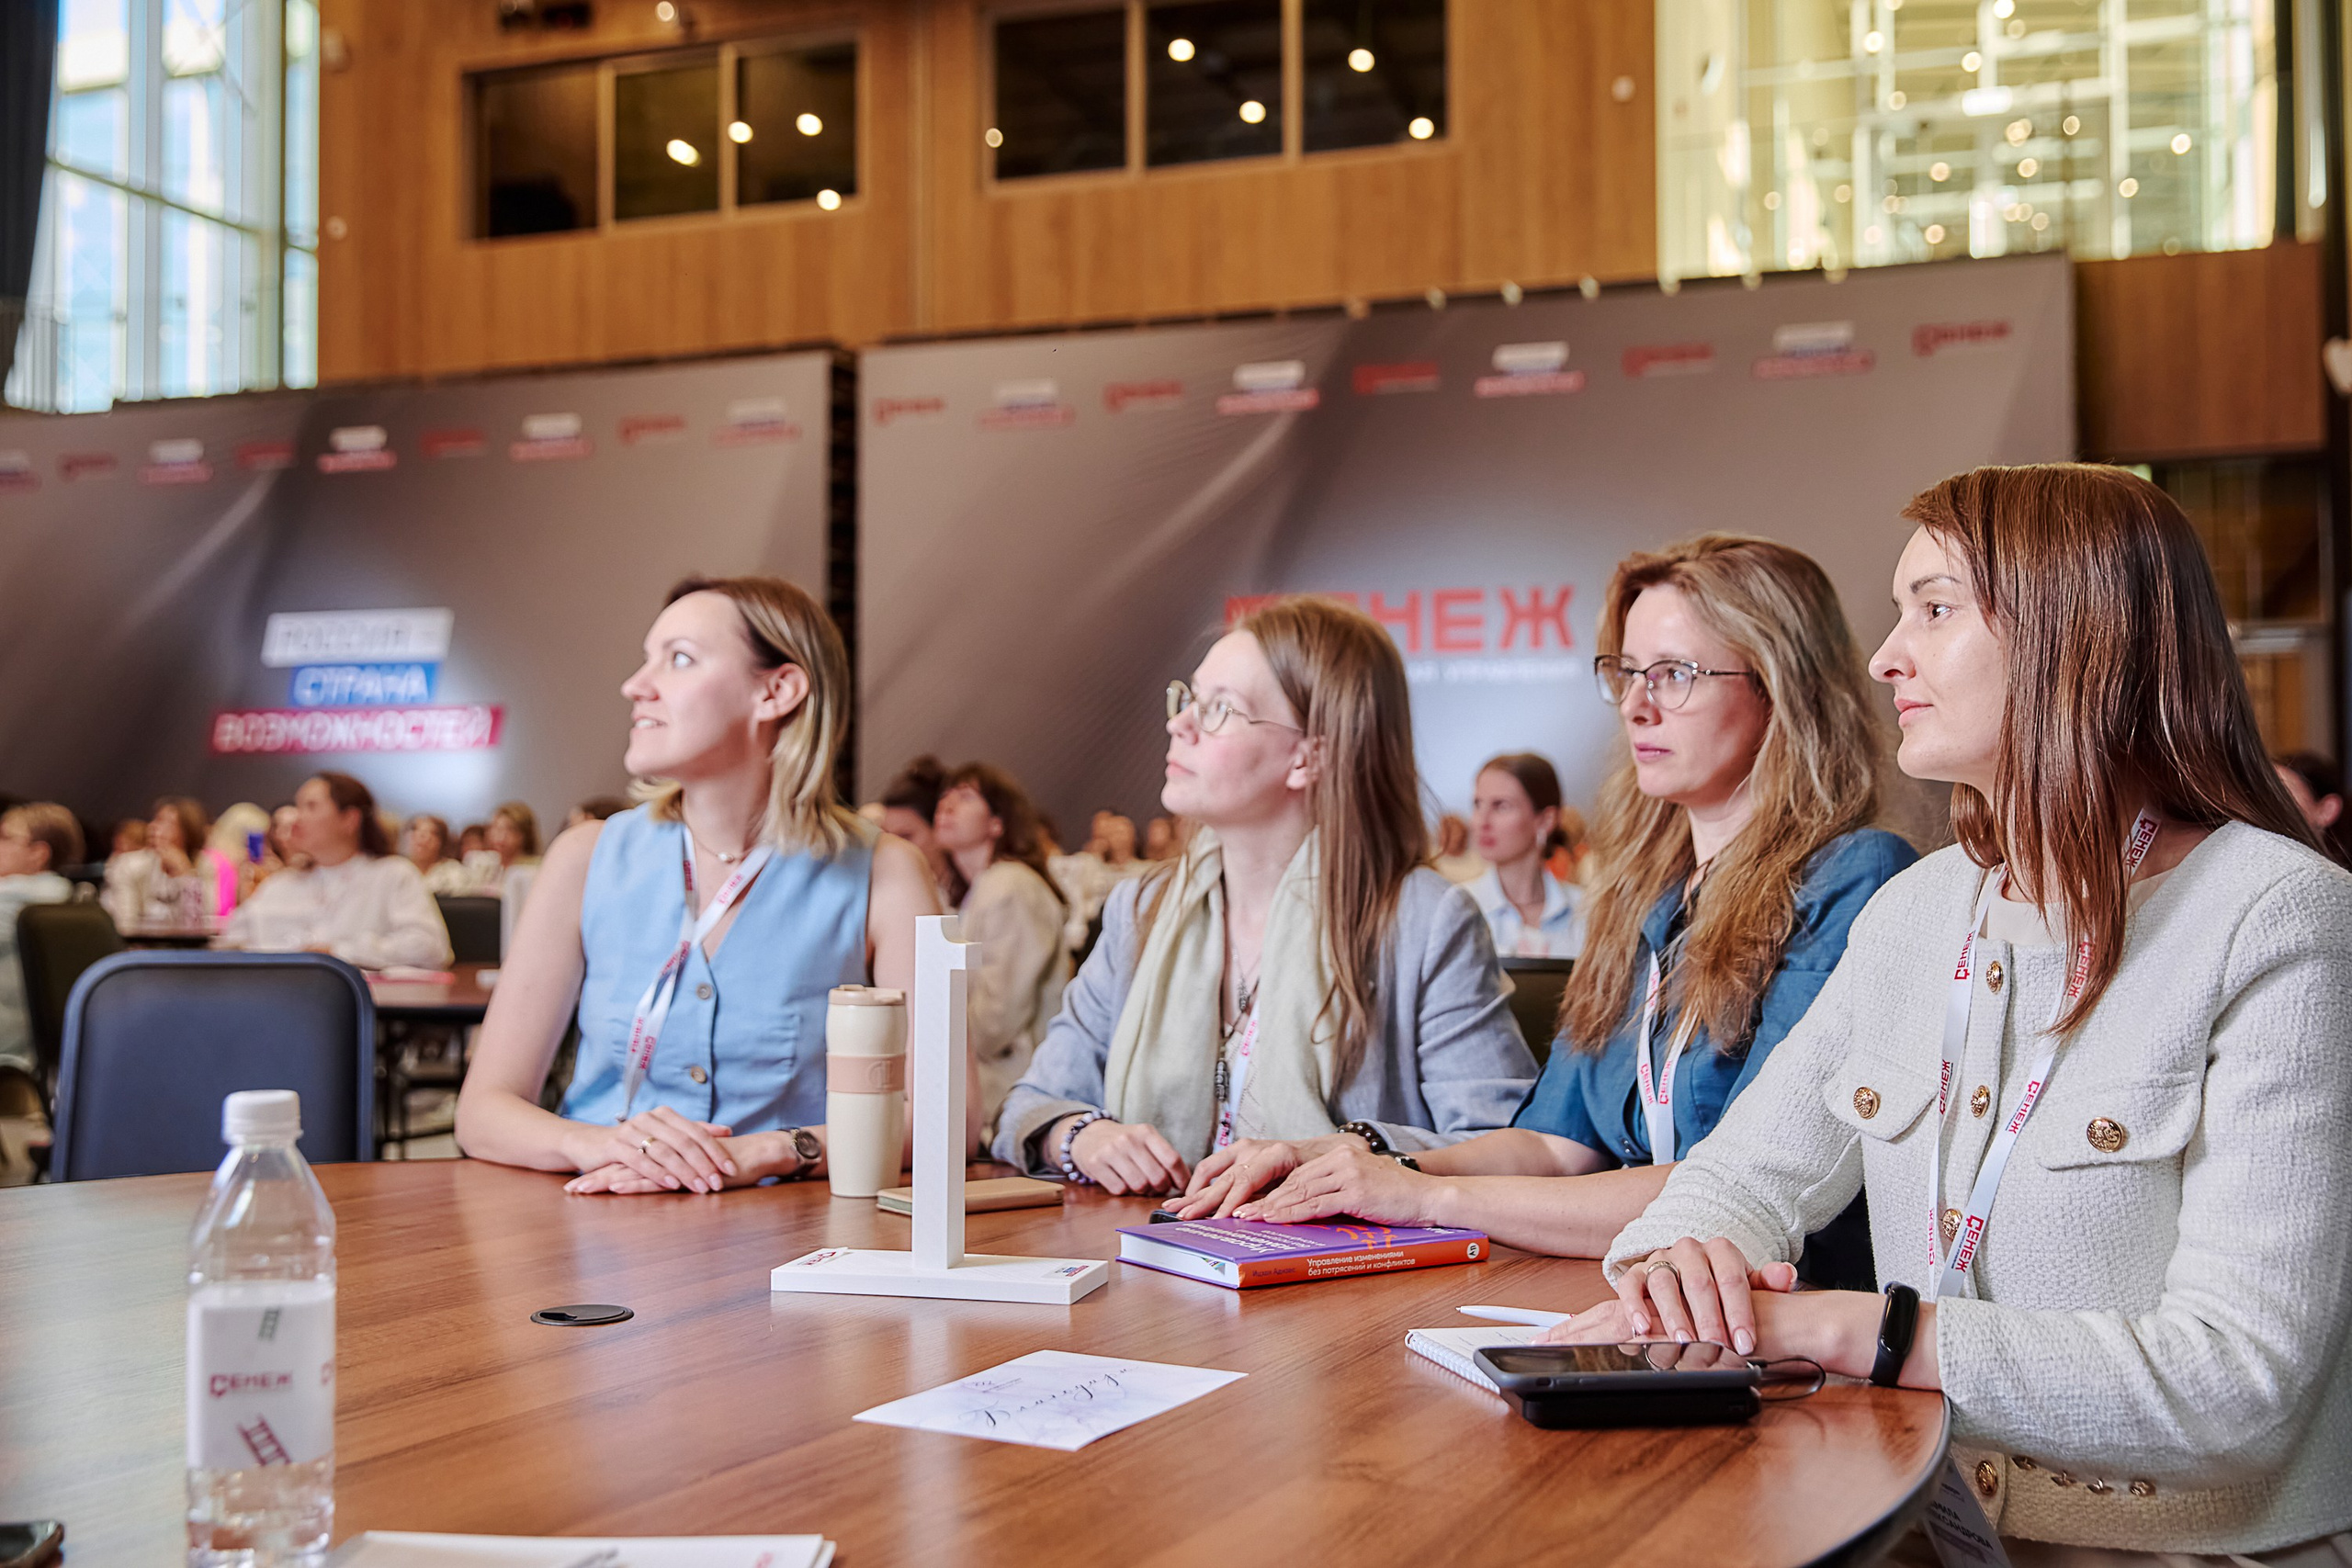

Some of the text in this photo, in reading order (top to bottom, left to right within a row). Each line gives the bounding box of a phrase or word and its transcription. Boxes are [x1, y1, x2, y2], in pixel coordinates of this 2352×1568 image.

[294, 665, 428, 705] СТРАНА
[212, 705, 493, 752] ВОЗМОЖНОСТЕЙ
[2008, 1080, 2041, 1134] СЕНЕЖ
[1306, 1250, 1404, 1268] Управление изменениями
[1955, 1214, 1984, 1273] СЕНЕЖ
[1307, 1267, 1321, 1276] без
[1322, 1262, 1366, 1275] потрясений
[1374, 1258, 1416, 1269] конфликтов
